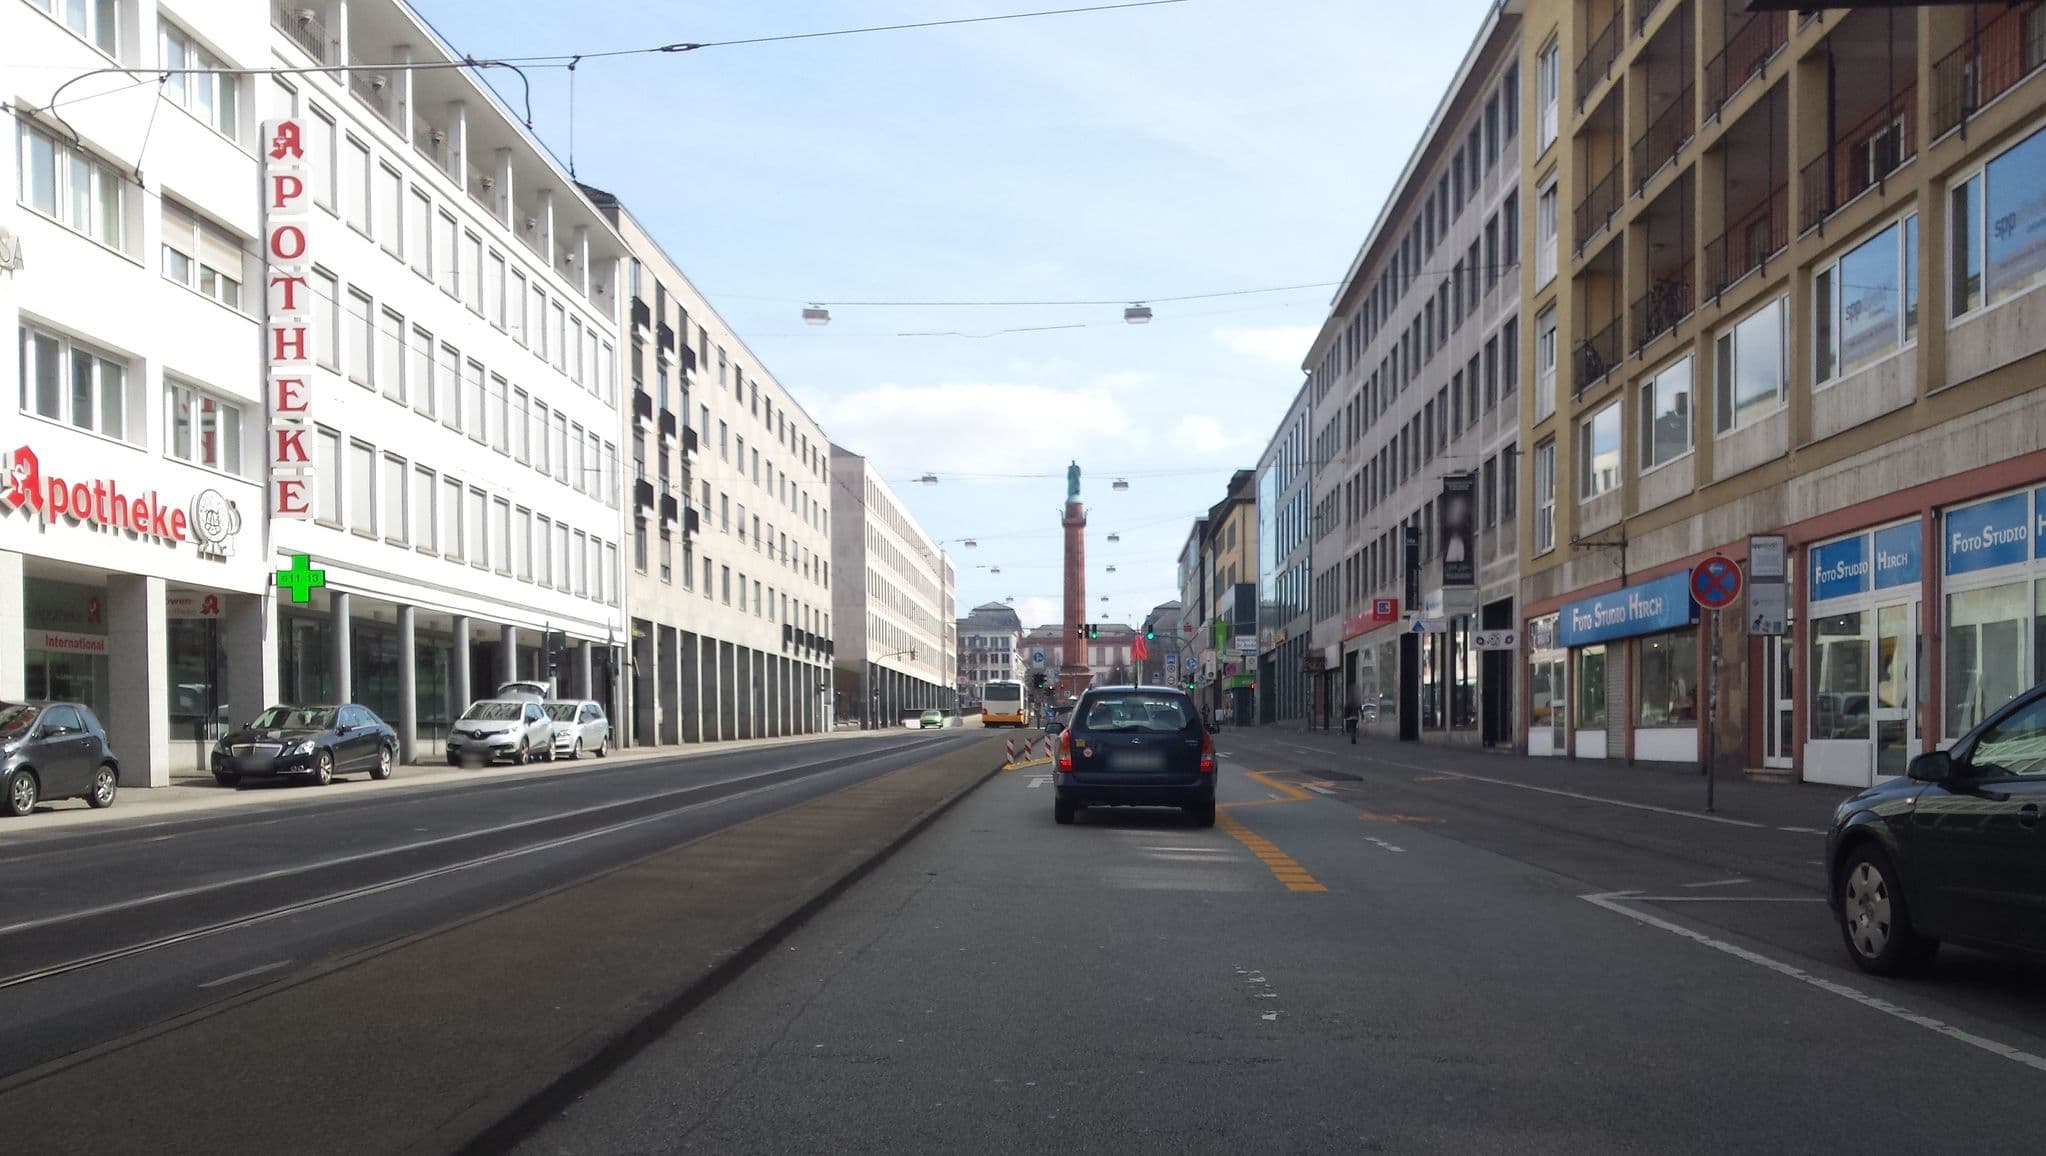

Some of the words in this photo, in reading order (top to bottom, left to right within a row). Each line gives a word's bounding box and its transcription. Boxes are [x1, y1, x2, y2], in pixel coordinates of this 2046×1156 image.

[269, 120, 311, 514] APOTHEKE
[7, 445, 187, 541] Apotheke
[1878, 551, 1908, 570] HIRCH
[1573, 608, 1592, 632] FOTO
[1594, 602, 1626, 628] STUDIO
[45, 634, 105, 652] International
